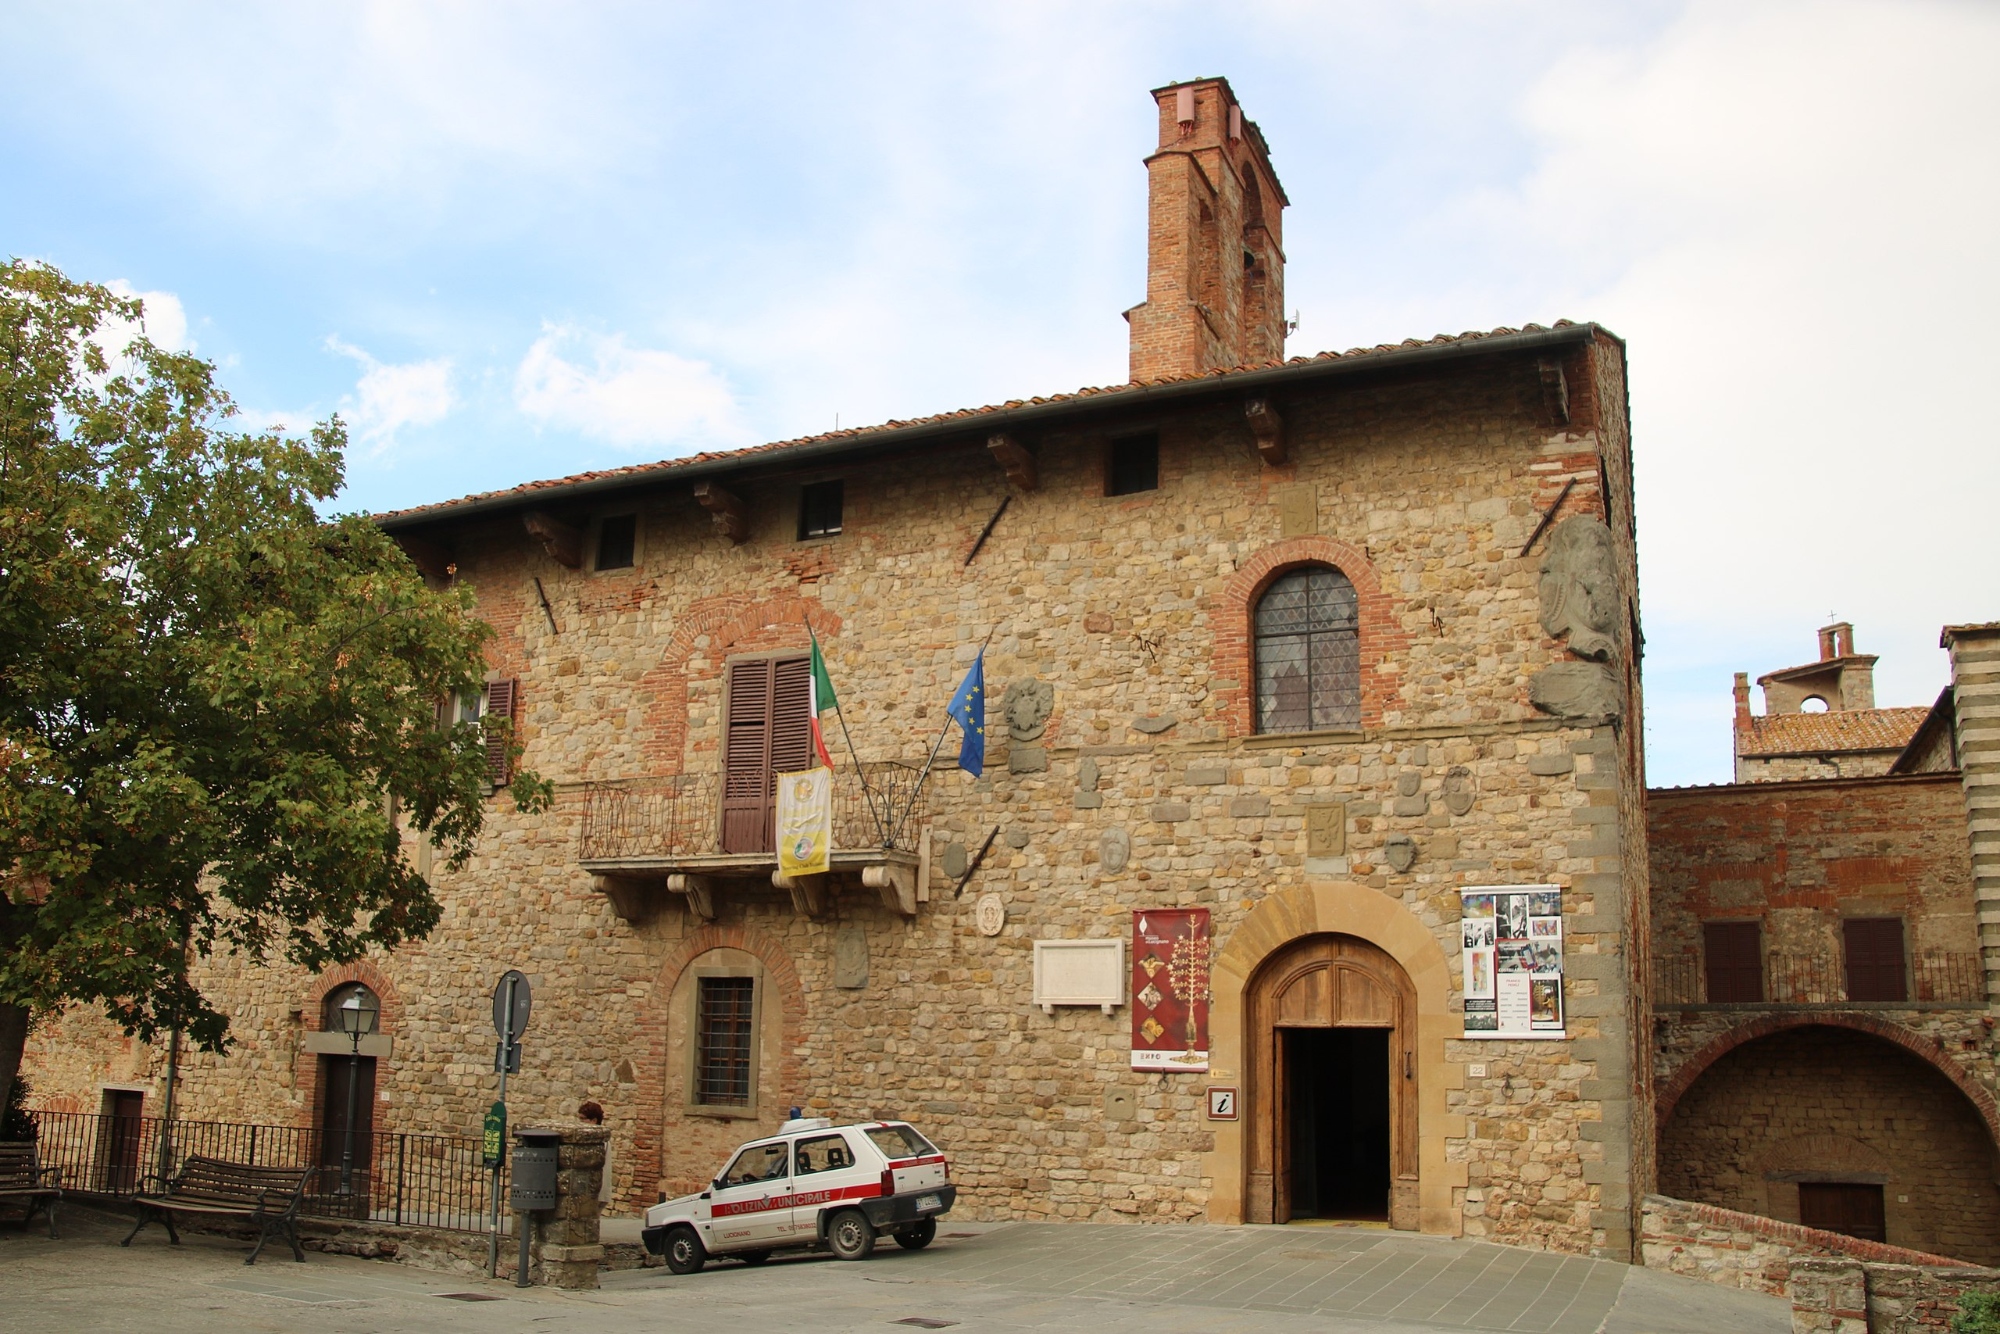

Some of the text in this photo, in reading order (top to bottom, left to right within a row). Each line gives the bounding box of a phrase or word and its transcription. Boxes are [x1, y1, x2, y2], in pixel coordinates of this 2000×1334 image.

[1472, 1066, 1483, 1075] 22
[1216, 1094, 1230, 1113] i
[769, 1190, 831, 1209] MUNICIPALE
[723, 1230, 751, 1239] LUCIGNANO
